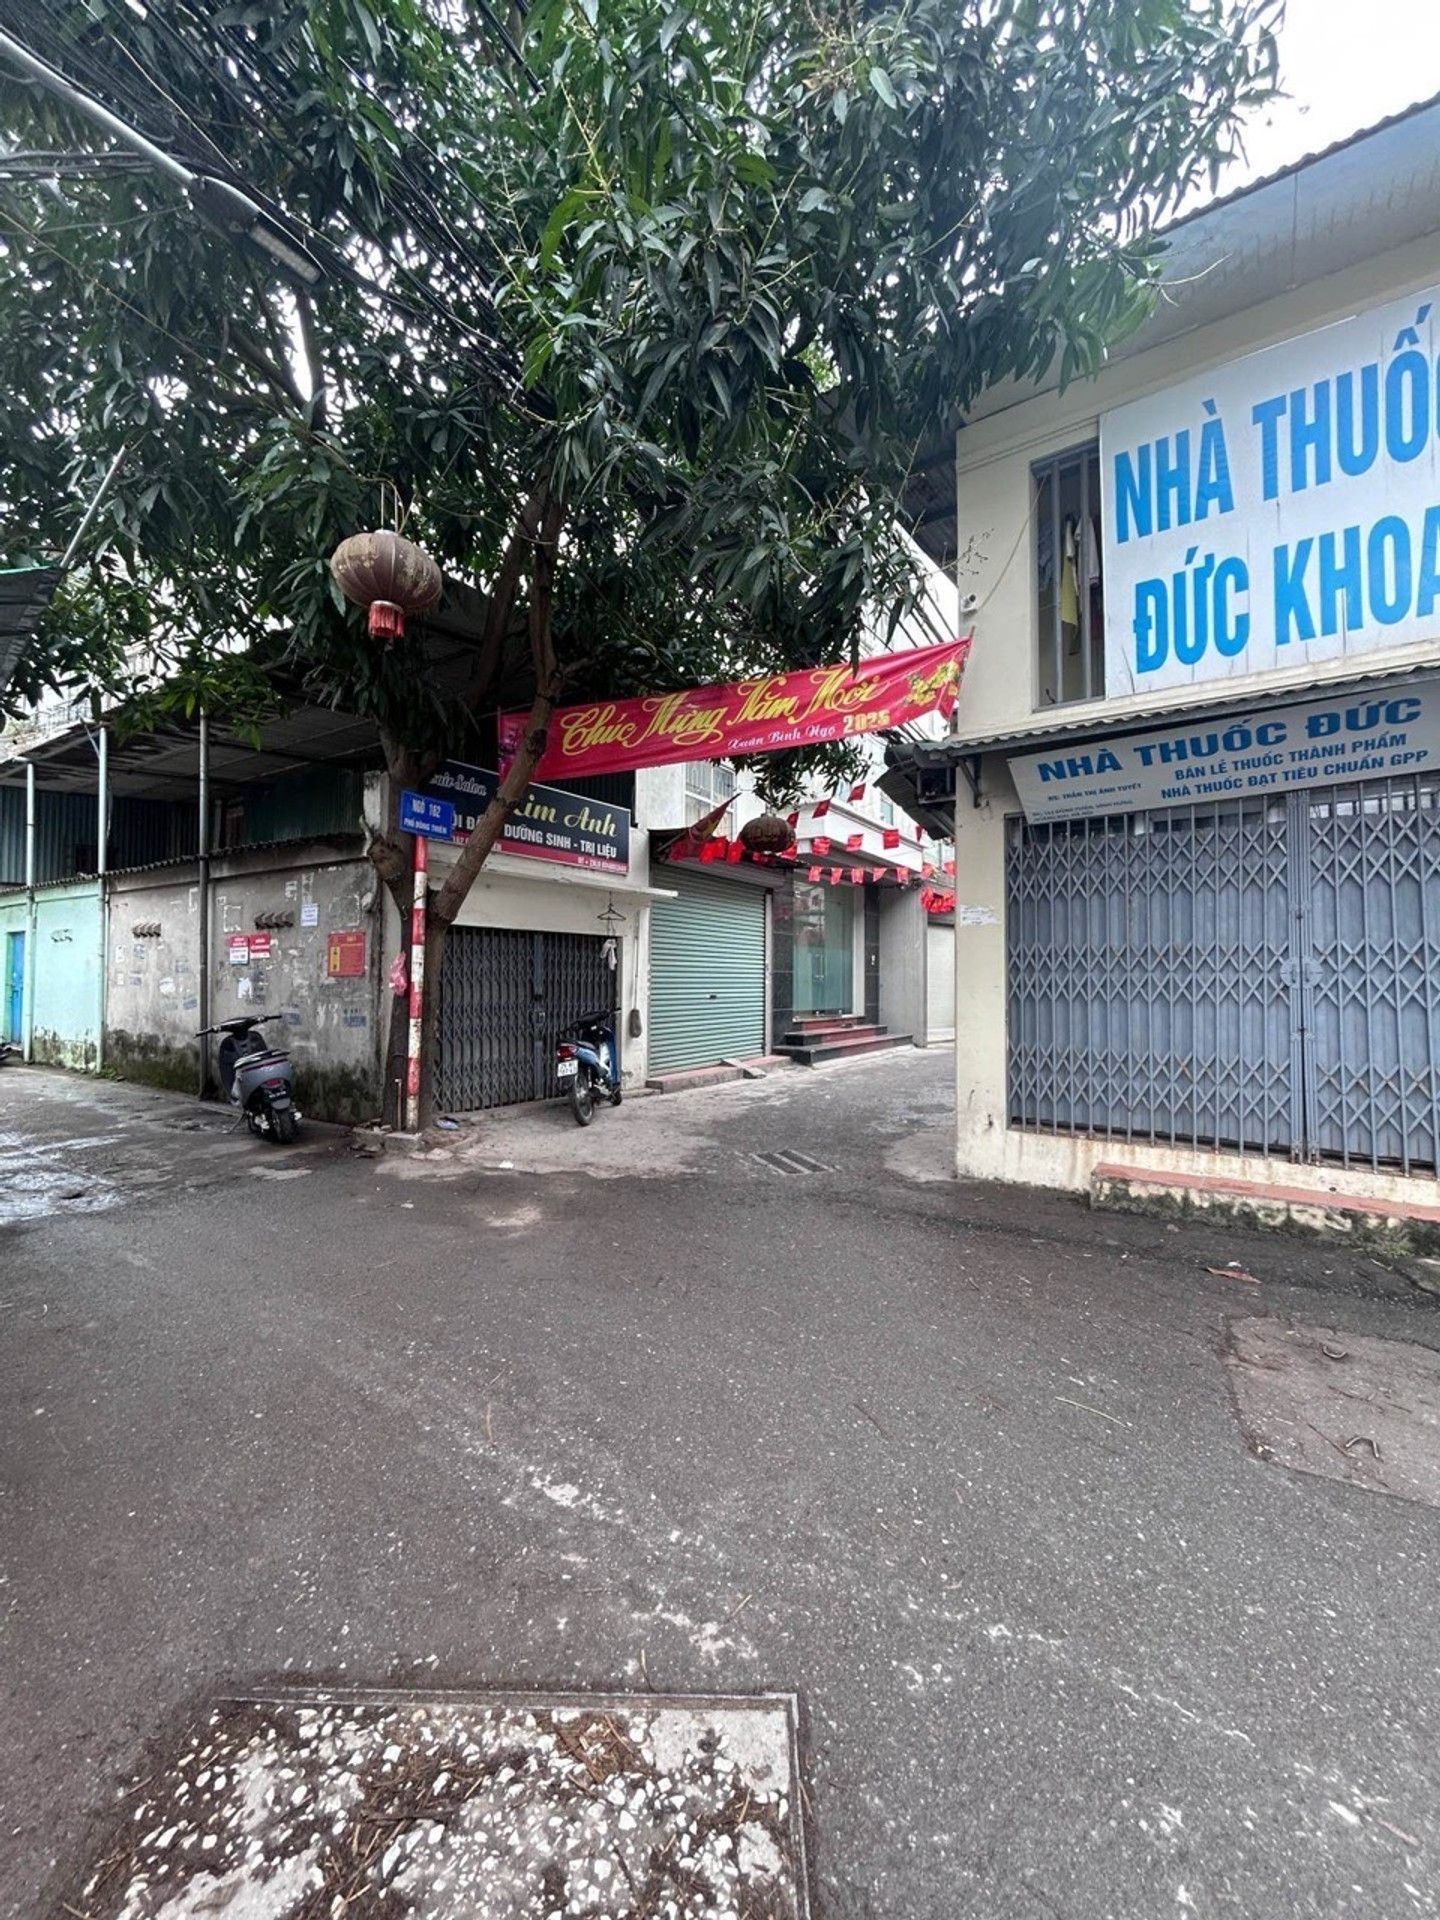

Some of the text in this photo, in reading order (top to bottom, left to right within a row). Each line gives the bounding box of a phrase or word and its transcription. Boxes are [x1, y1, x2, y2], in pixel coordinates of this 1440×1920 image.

[1115, 303, 1440, 544] NHÀ THUỐ
[1133, 546, 1249, 674] ĐỨC
[560, 704, 638, 756] Chúc
[623, 691, 728, 748] Mừng
[726, 675, 800, 725] Năm
[1037, 698, 1422, 782] NHÀ THUỐC ĐỨC
[1161, 784, 1191, 799] NHÀ
[1194, 775, 1243, 795] THUỐC
[1248, 772, 1277, 789] ĐẠT
[1282, 765, 1318, 782] TIÊU
[1390, 749, 1429, 767] GPP
[1174, 765, 1206, 781] BÁN
[1233, 751, 1284, 773] THUỐC
[1288, 742, 1346, 763] THÀNH
[504, 823, 543, 844] DƯỠNG
[545, 832, 572, 850] SINH
[580, 839, 596, 857] TRỊ
[597, 842, 618, 860] LIỆU
[513, 793, 618, 838] im Anh
